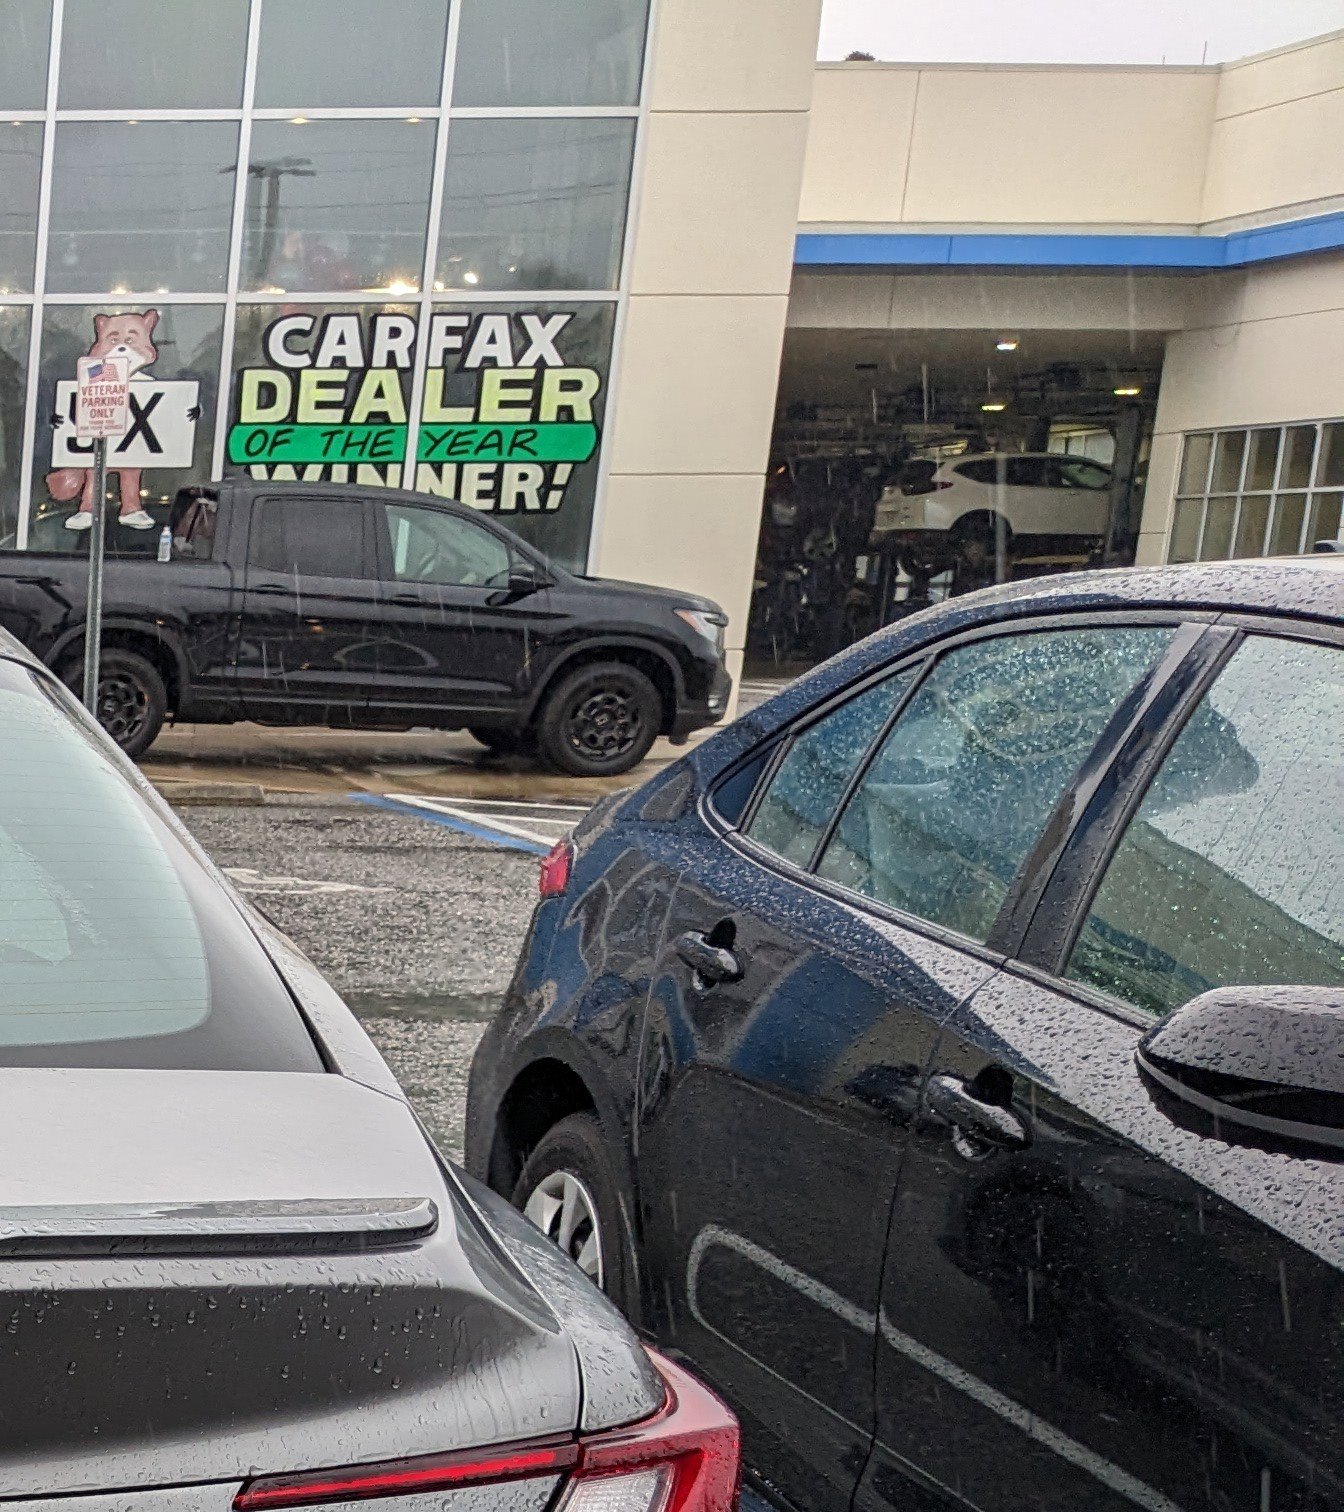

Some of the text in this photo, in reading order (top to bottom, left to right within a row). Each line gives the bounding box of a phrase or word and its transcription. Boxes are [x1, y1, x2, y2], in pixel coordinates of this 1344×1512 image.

[268, 313, 572, 368] CARFAX
[81, 385, 126, 396] VETERAN
[239, 367, 600, 424] DEALER
[81, 396, 125, 408] PARKING
[90, 408, 115, 419] ONLY
[244, 428, 539, 457] OF THE YEAR
